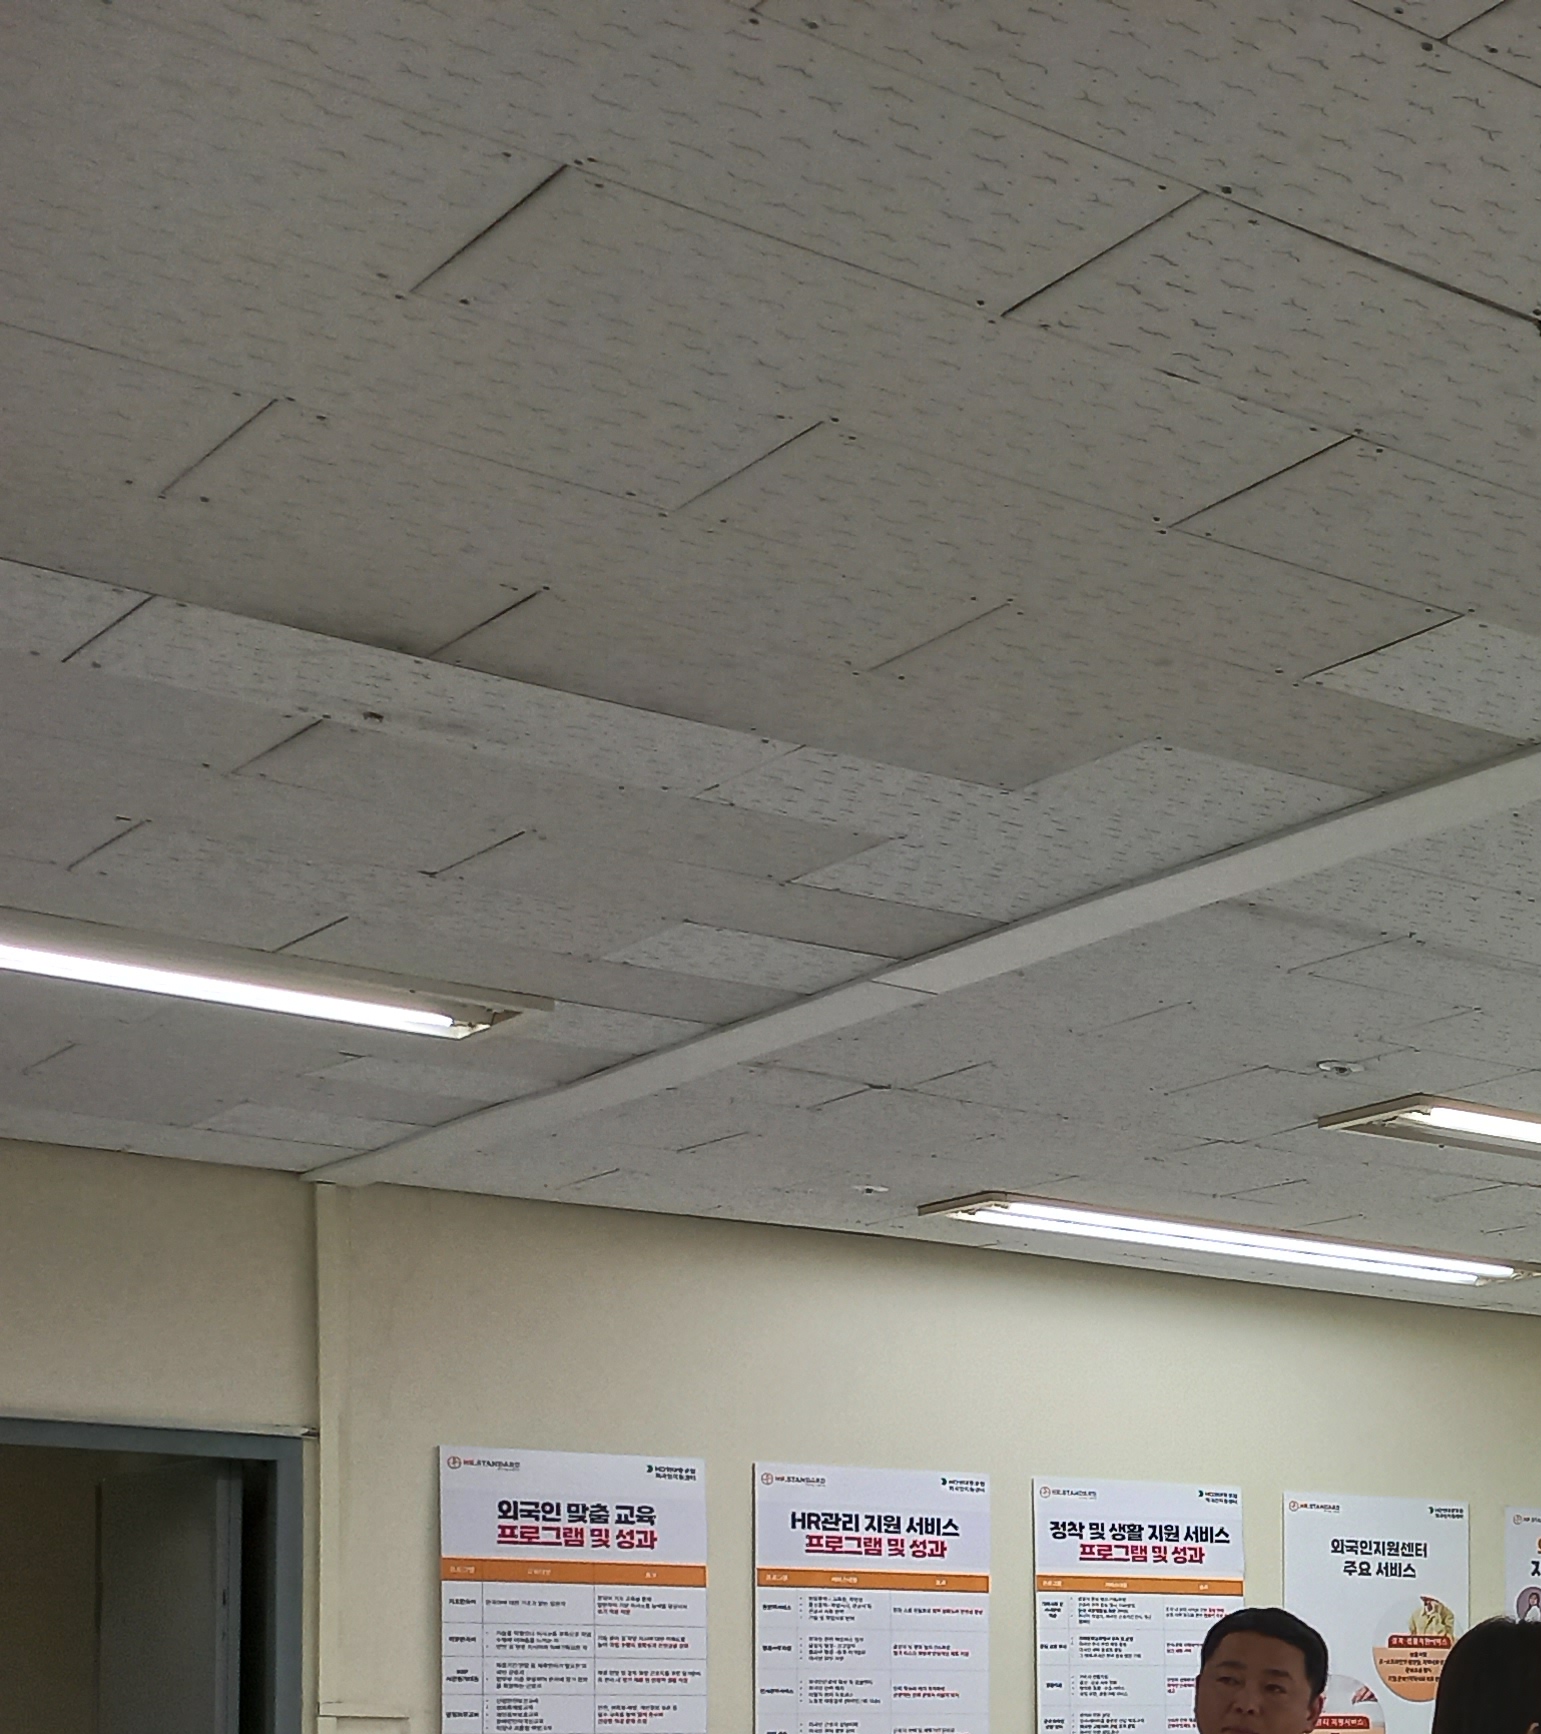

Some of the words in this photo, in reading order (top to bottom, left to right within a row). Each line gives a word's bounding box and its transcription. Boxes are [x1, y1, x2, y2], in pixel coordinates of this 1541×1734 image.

[497, 1500, 561, 1522] 외국인
[566, 1502, 610, 1524] 맞춤
[614, 1504, 657, 1526] 교육
[791, 1511, 859, 1532] HR관리
[864, 1514, 901, 1534] 지원
[906, 1516, 960, 1536] 서비스
[497, 1525, 585, 1547] 프로그램
[590, 1528, 611, 1548] 및
[616, 1529, 658, 1550] 성과
[1049, 1521, 1085, 1540] 정착
[1089, 1522, 1105, 1540] 및
[1109, 1523, 1144, 1542] 생활
[1148, 1524, 1180, 1542] 지원
[1184, 1526, 1230, 1544] 서비스
[805, 1534, 882, 1556] 프로그램
[888, 1538, 904, 1557] 및
[909, 1539, 948, 1558] 성과
[1079, 1543, 1148, 1562] 프로그램
[1152, 1545, 1168, 1563] 및
[1172, 1547, 1205, 1564] 성과
[1331, 1538, 1428, 1558] 외국인지원센터
[1343, 1561, 1372, 1577] 주요
[1375, 1562, 1416, 1578] 서비스
